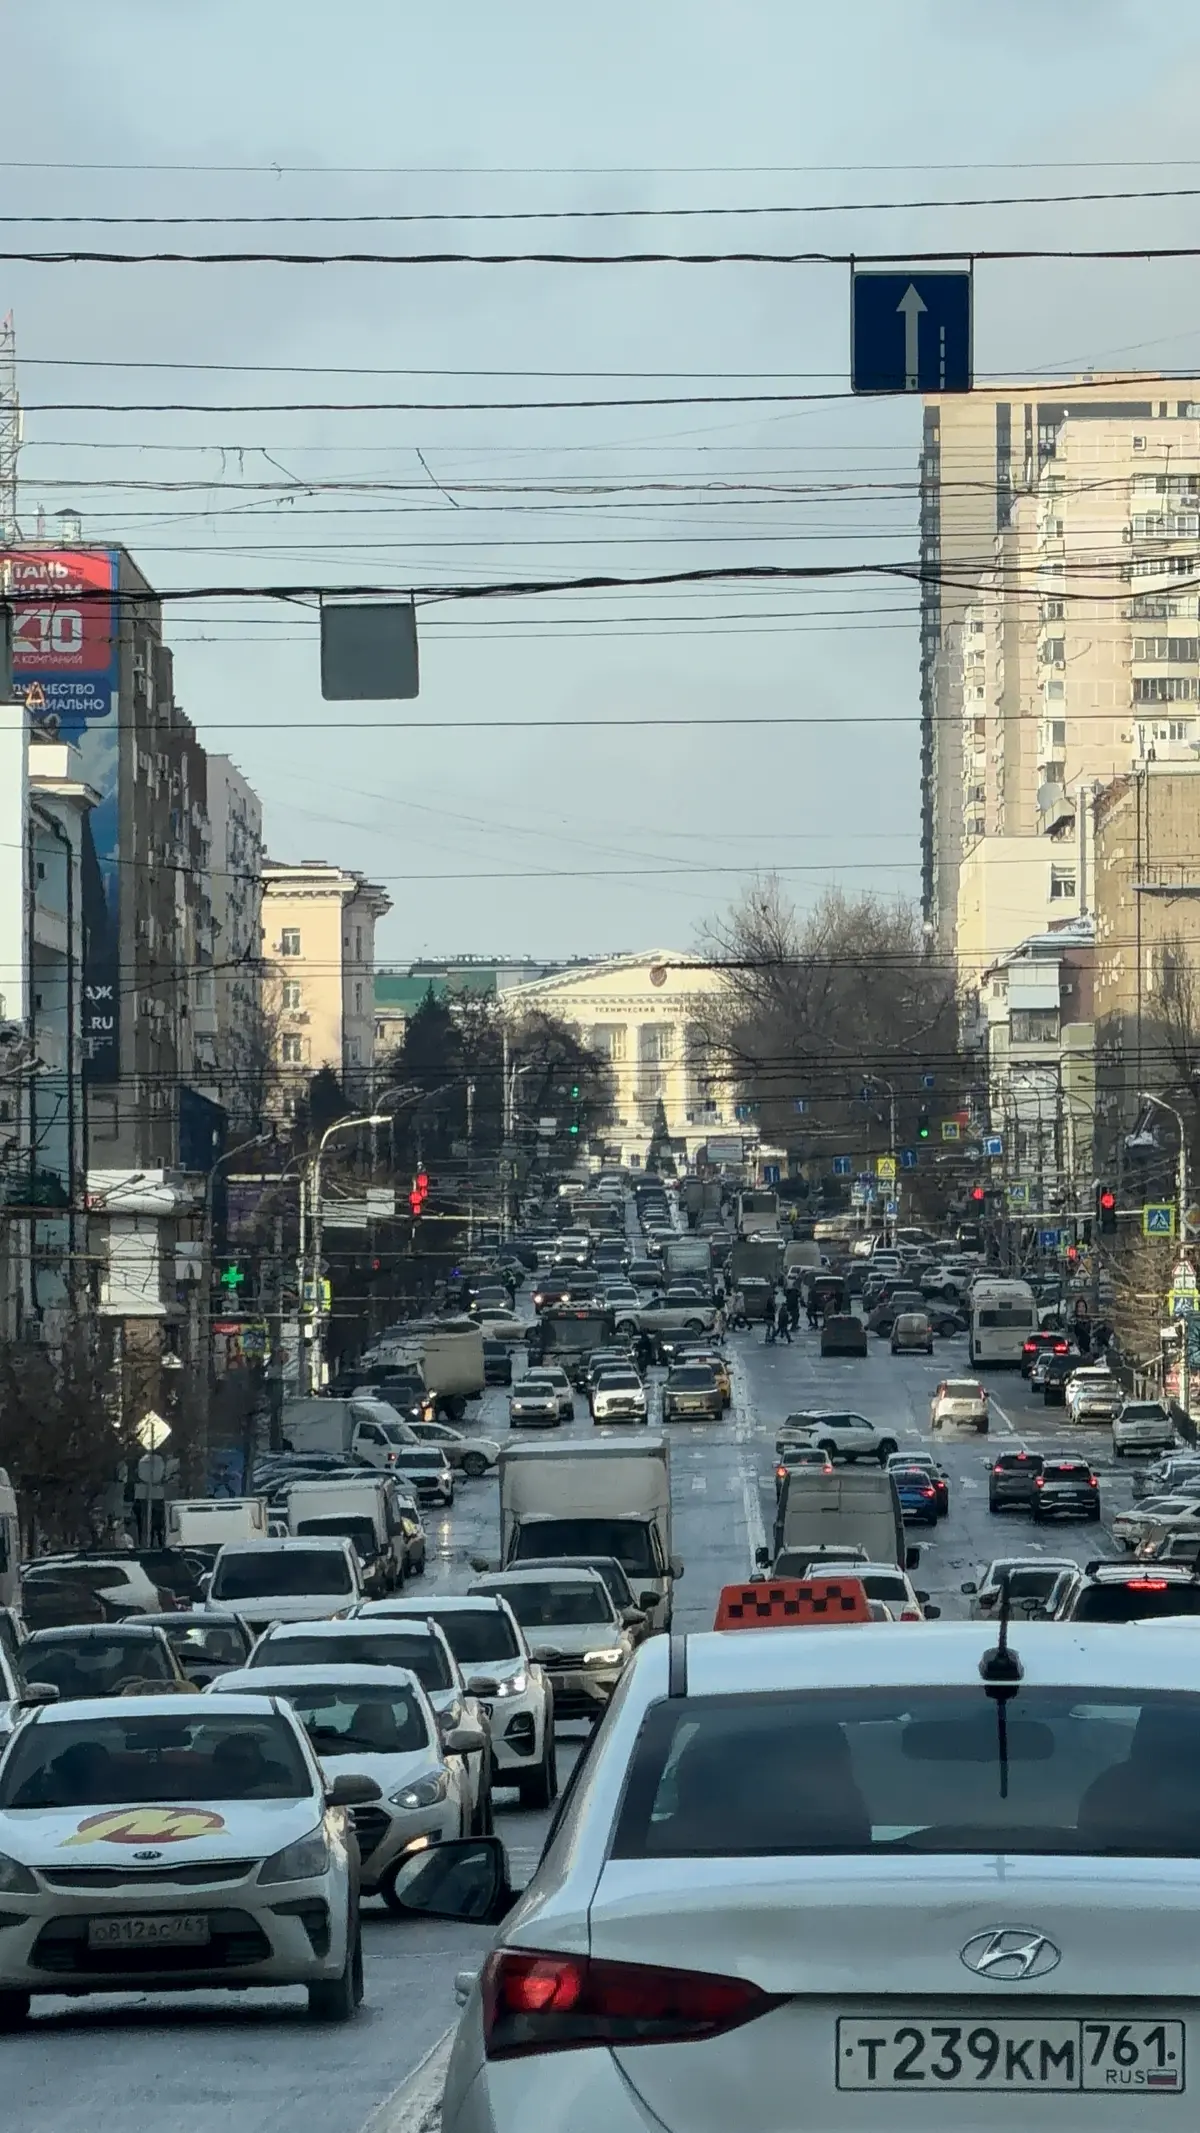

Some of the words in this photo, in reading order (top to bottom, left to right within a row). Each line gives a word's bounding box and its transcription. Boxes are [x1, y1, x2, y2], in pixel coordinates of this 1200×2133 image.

[22, 654, 83, 664] КОМПАНИЙ
[858, 2027, 1075, 2081] Т239КМ
[1085, 2025, 1166, 2067] 761
[1106, 2069, 1145, 2084] RUS
